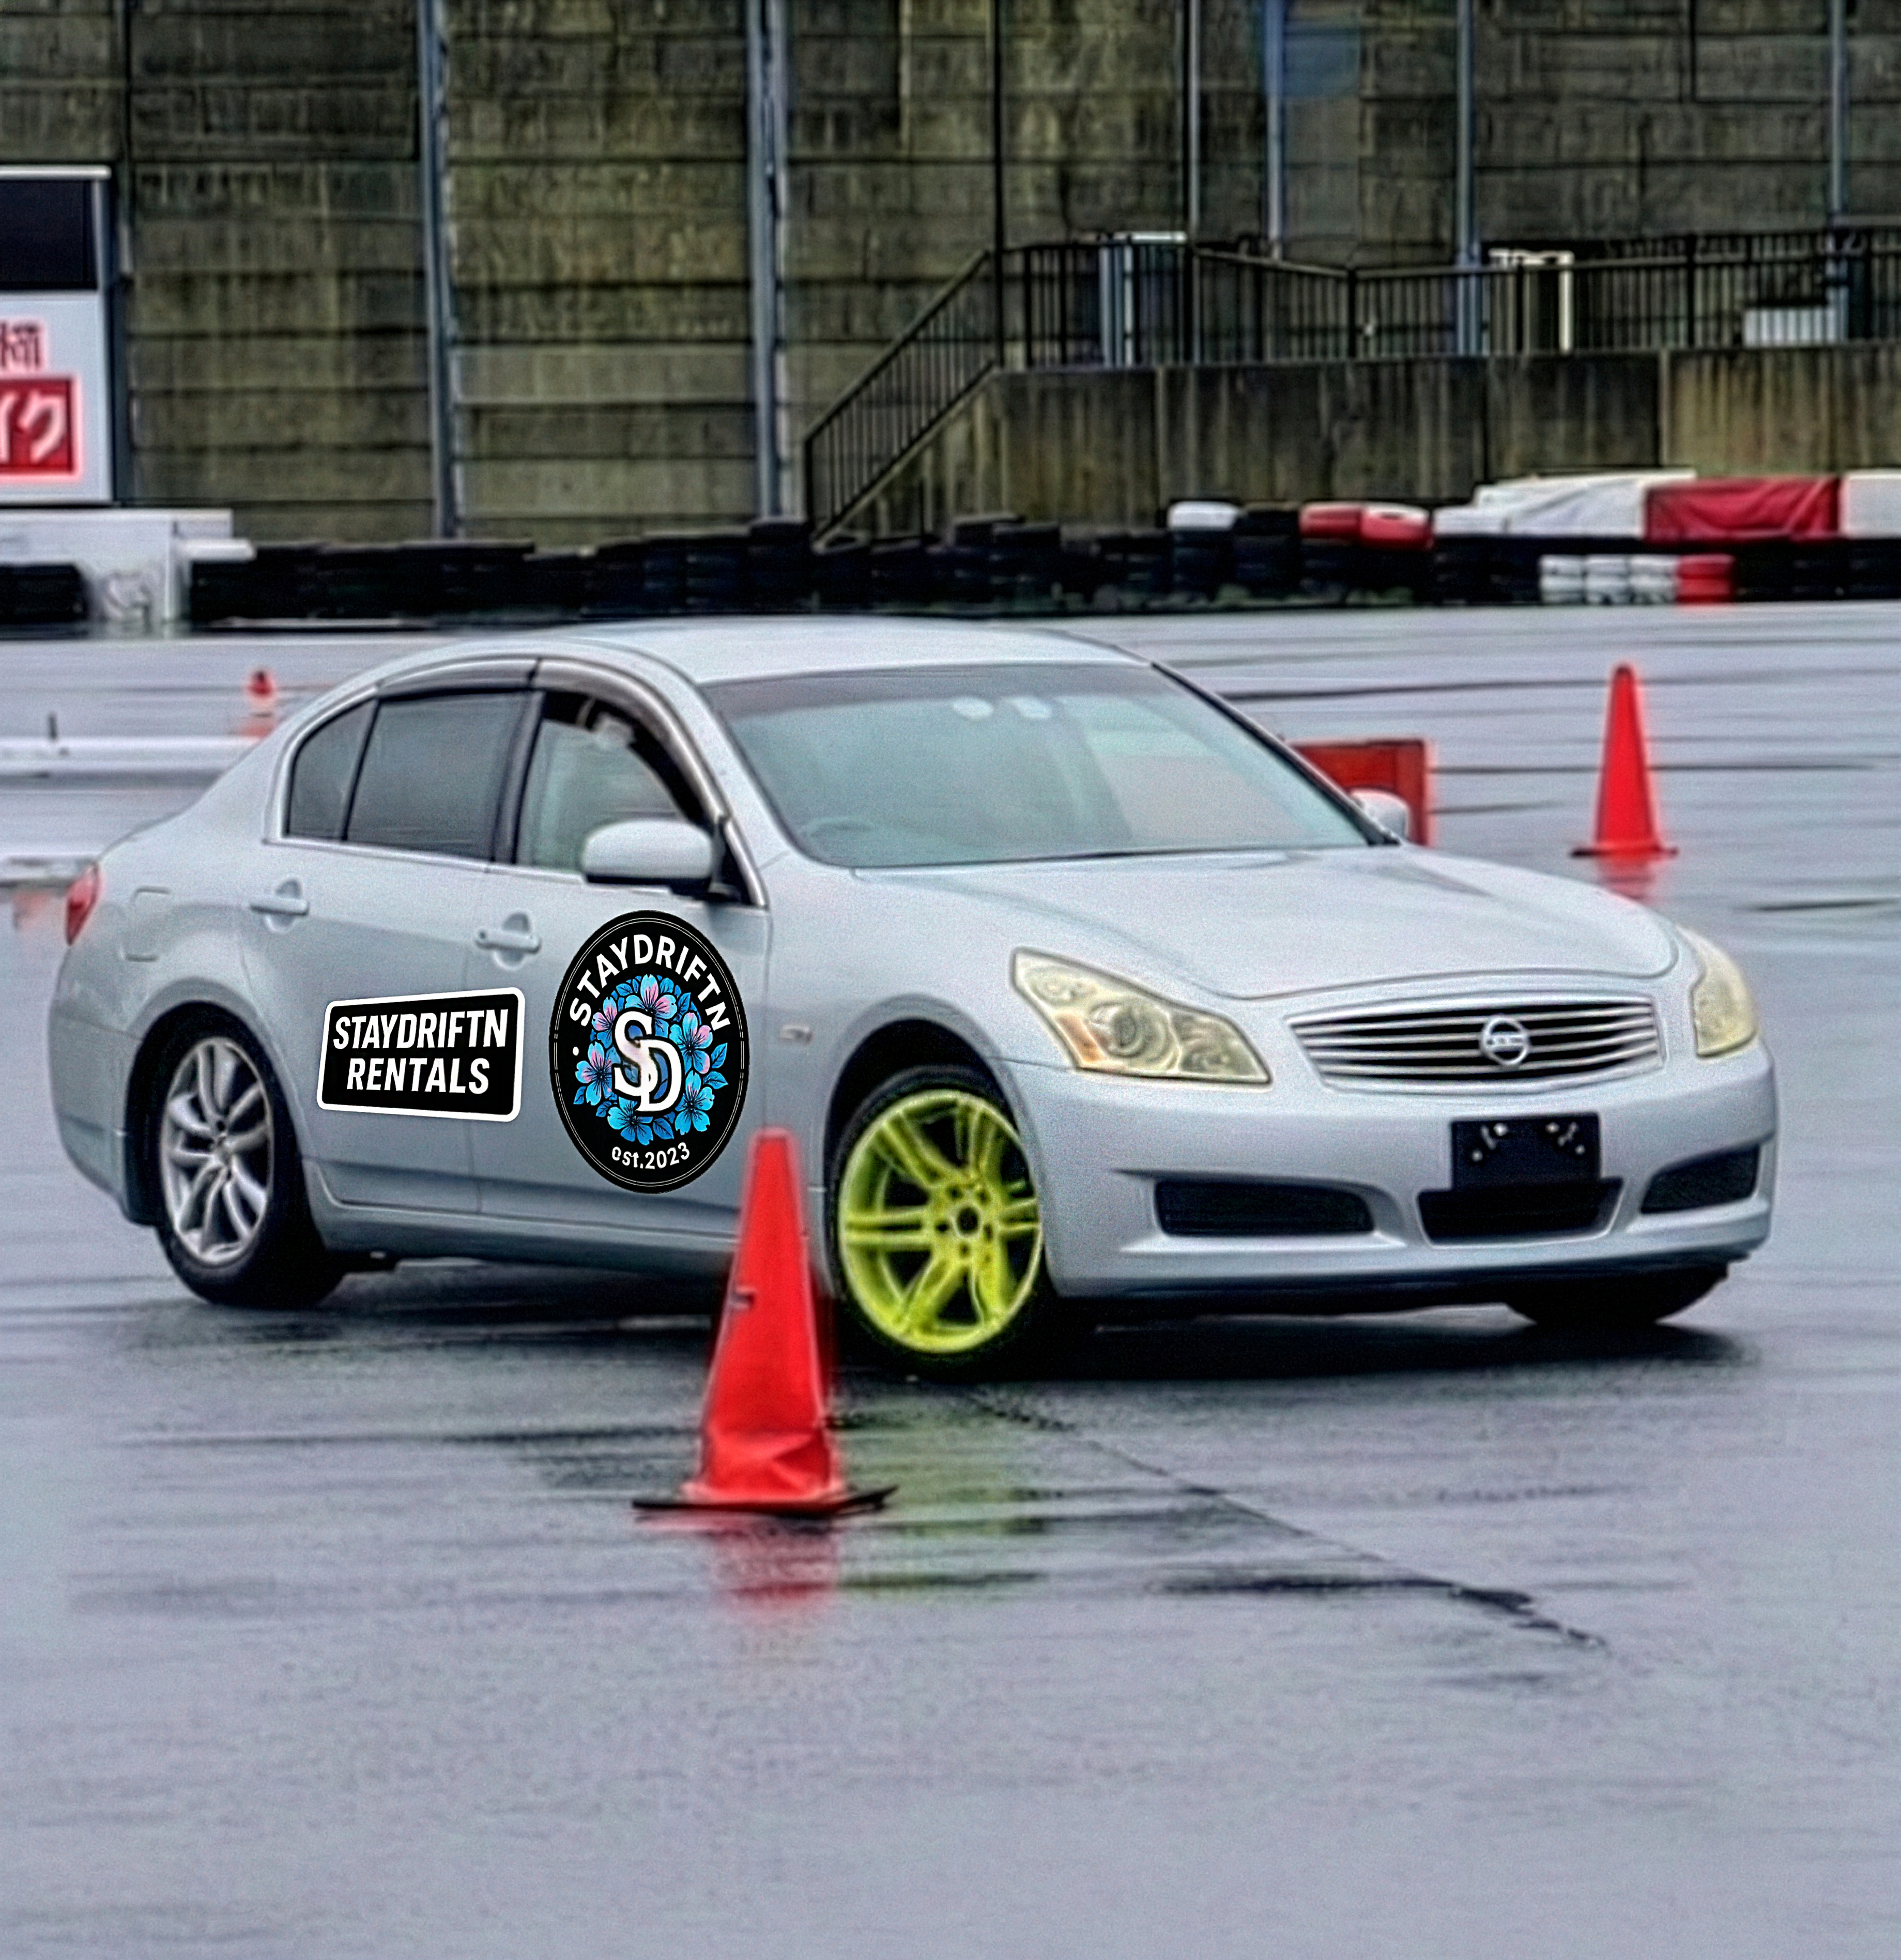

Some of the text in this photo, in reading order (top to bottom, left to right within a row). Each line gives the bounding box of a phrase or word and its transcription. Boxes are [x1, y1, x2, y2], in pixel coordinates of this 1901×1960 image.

[569, 933, 731, 1031] STAYDRIFTN
[333, 1008, 509, 1050] STAYDRIFTN
[346, 1058, 490, 1095] RENTALS
